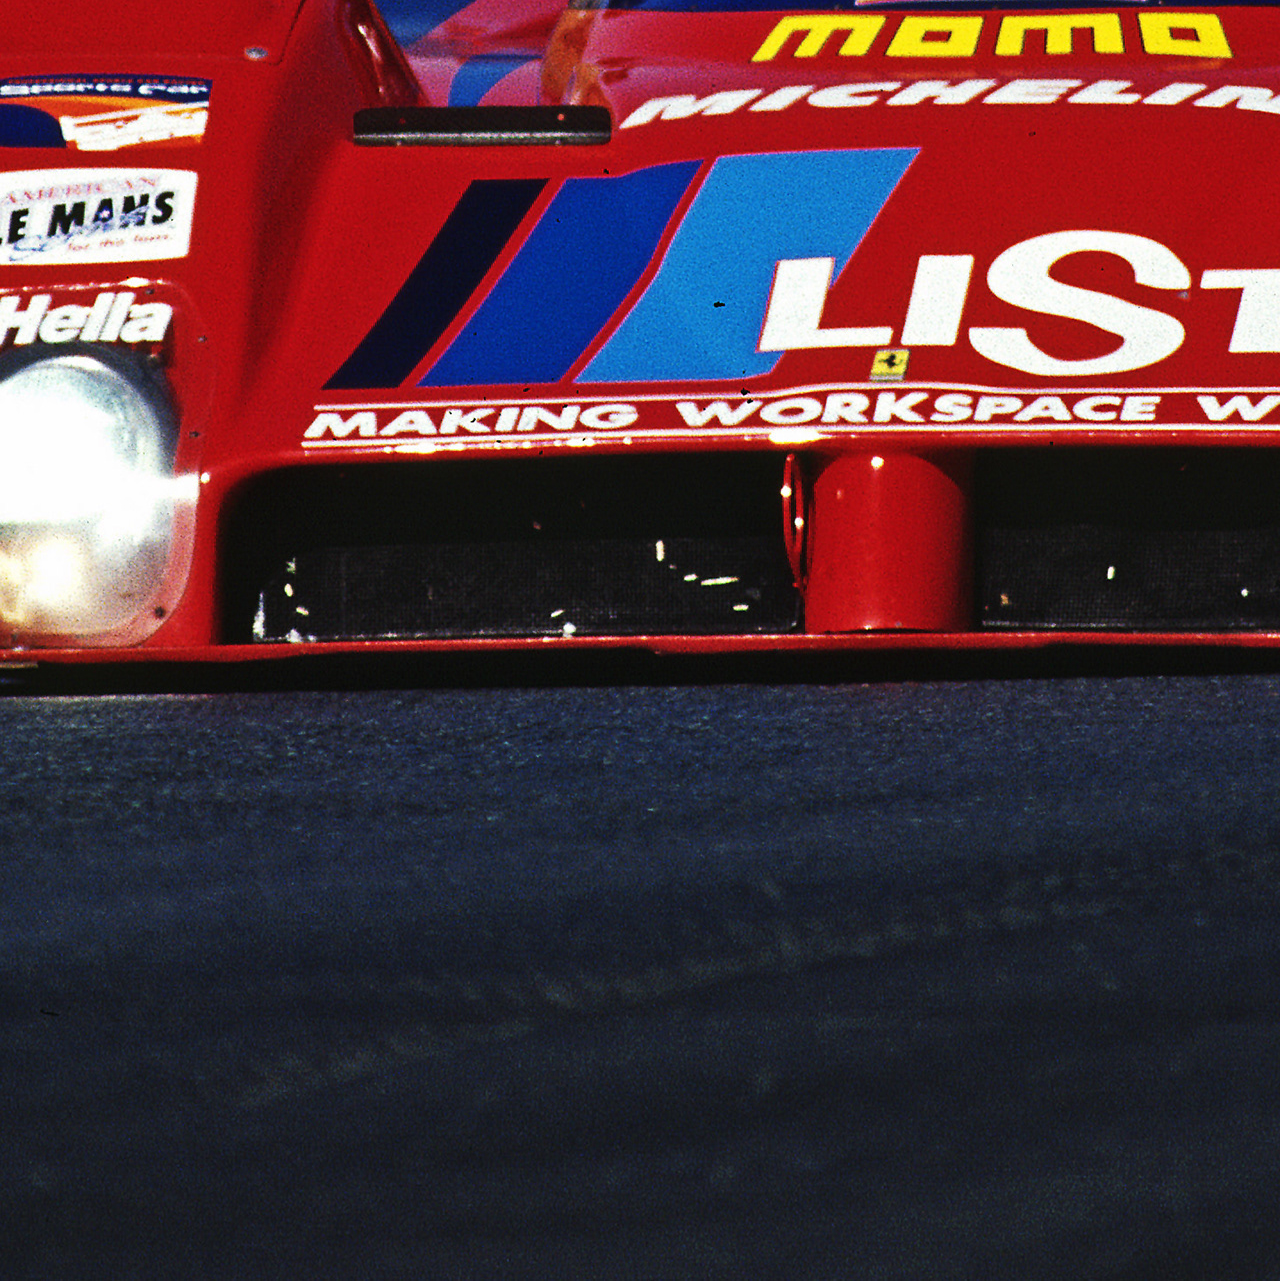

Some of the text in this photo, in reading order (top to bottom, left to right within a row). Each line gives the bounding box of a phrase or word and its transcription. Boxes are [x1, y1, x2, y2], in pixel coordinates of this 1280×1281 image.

[0, 175, 162, 206] AMERICAN
[46, 190, 176, 239] MANS
[303, 403, 639, 439] MAKING
[676, 391, 1162, 426] WORKSPACE
